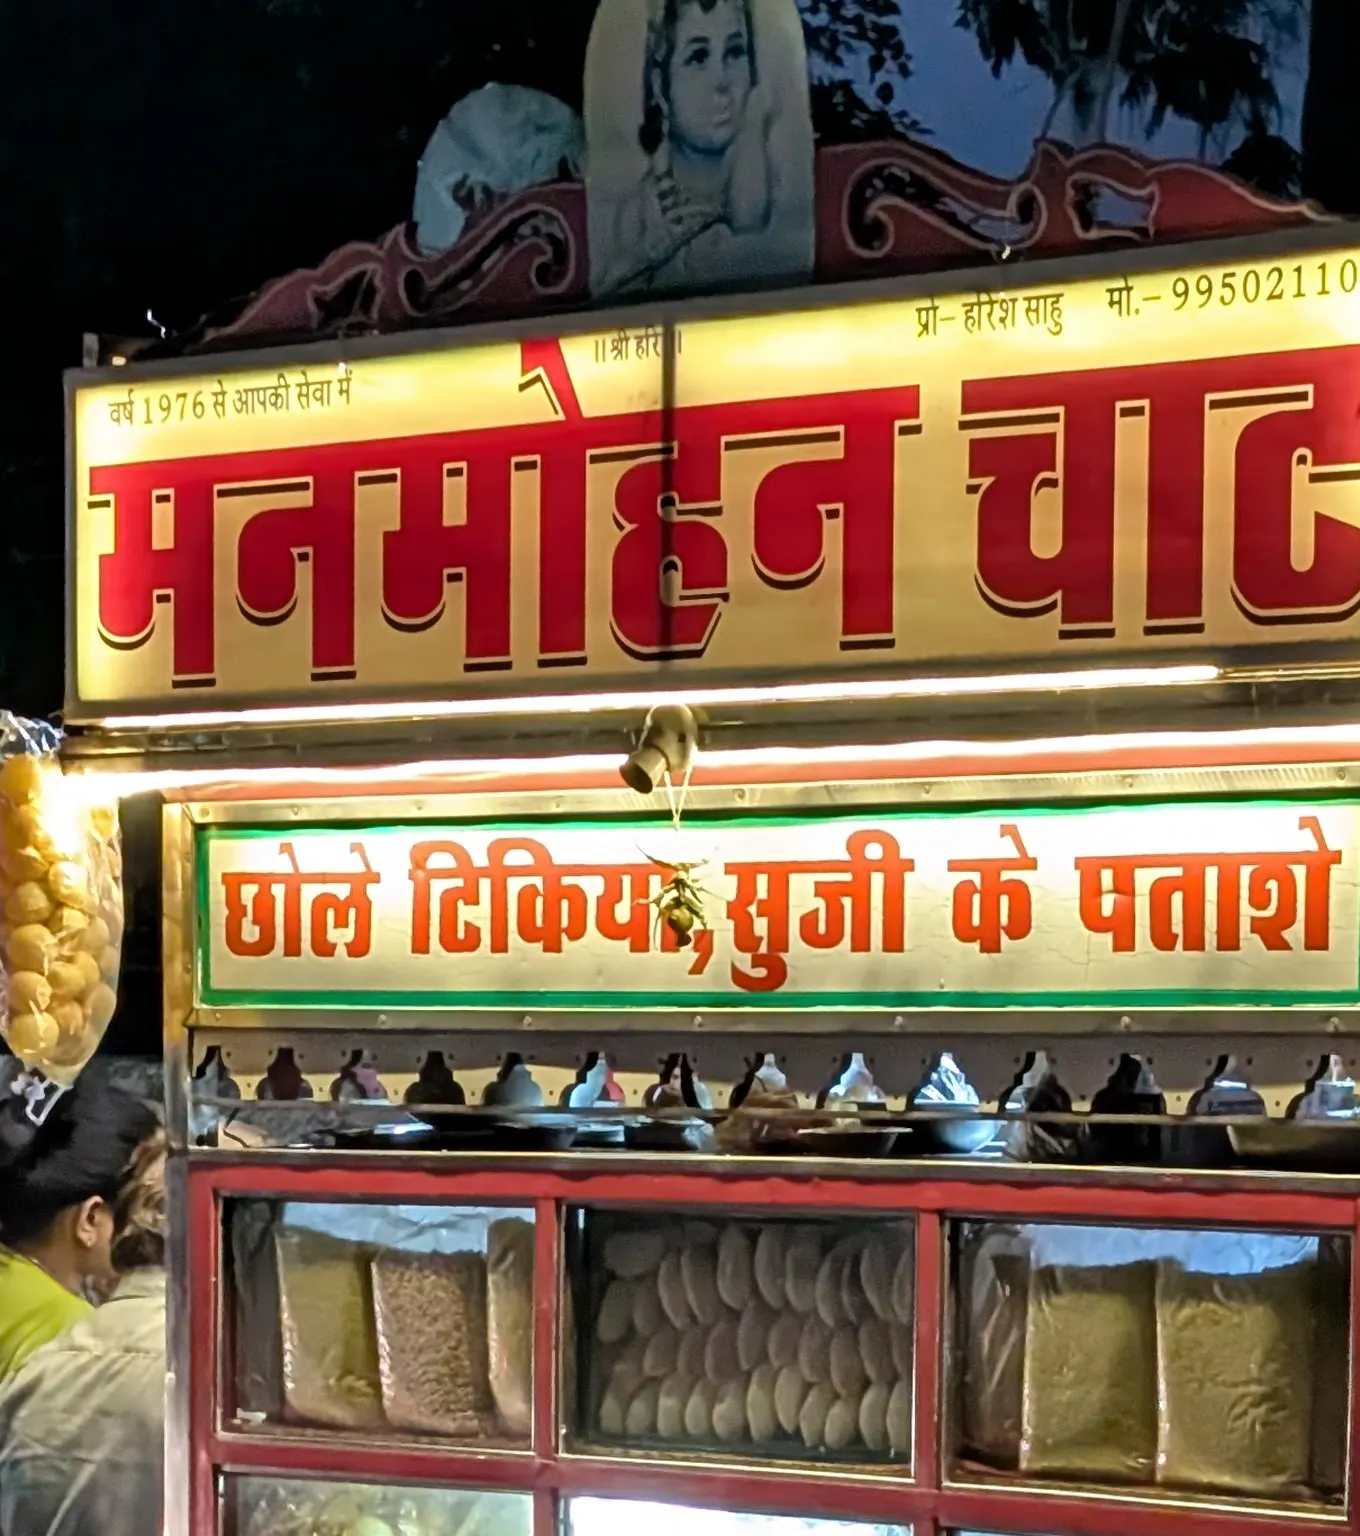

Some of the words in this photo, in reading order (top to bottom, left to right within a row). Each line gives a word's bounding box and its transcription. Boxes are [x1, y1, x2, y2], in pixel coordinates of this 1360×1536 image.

[1023, 292, 1064, 336] साहु
[108, 388, 135, 427] वर्ष
[143, 390, 206, 425] 1976
[211, 378, 228, 419] से
[233, 372, 291, 416] आपकी
[295, 369, 333, 410] सेवा
[337, 368, 353, 406] में
[88, 338, 923, 689] मनमोहन
[221, 841, 381, 958] छोले
[947, 824, 1038, 954] के
[1074, 816, 1342, 952] पताशे
